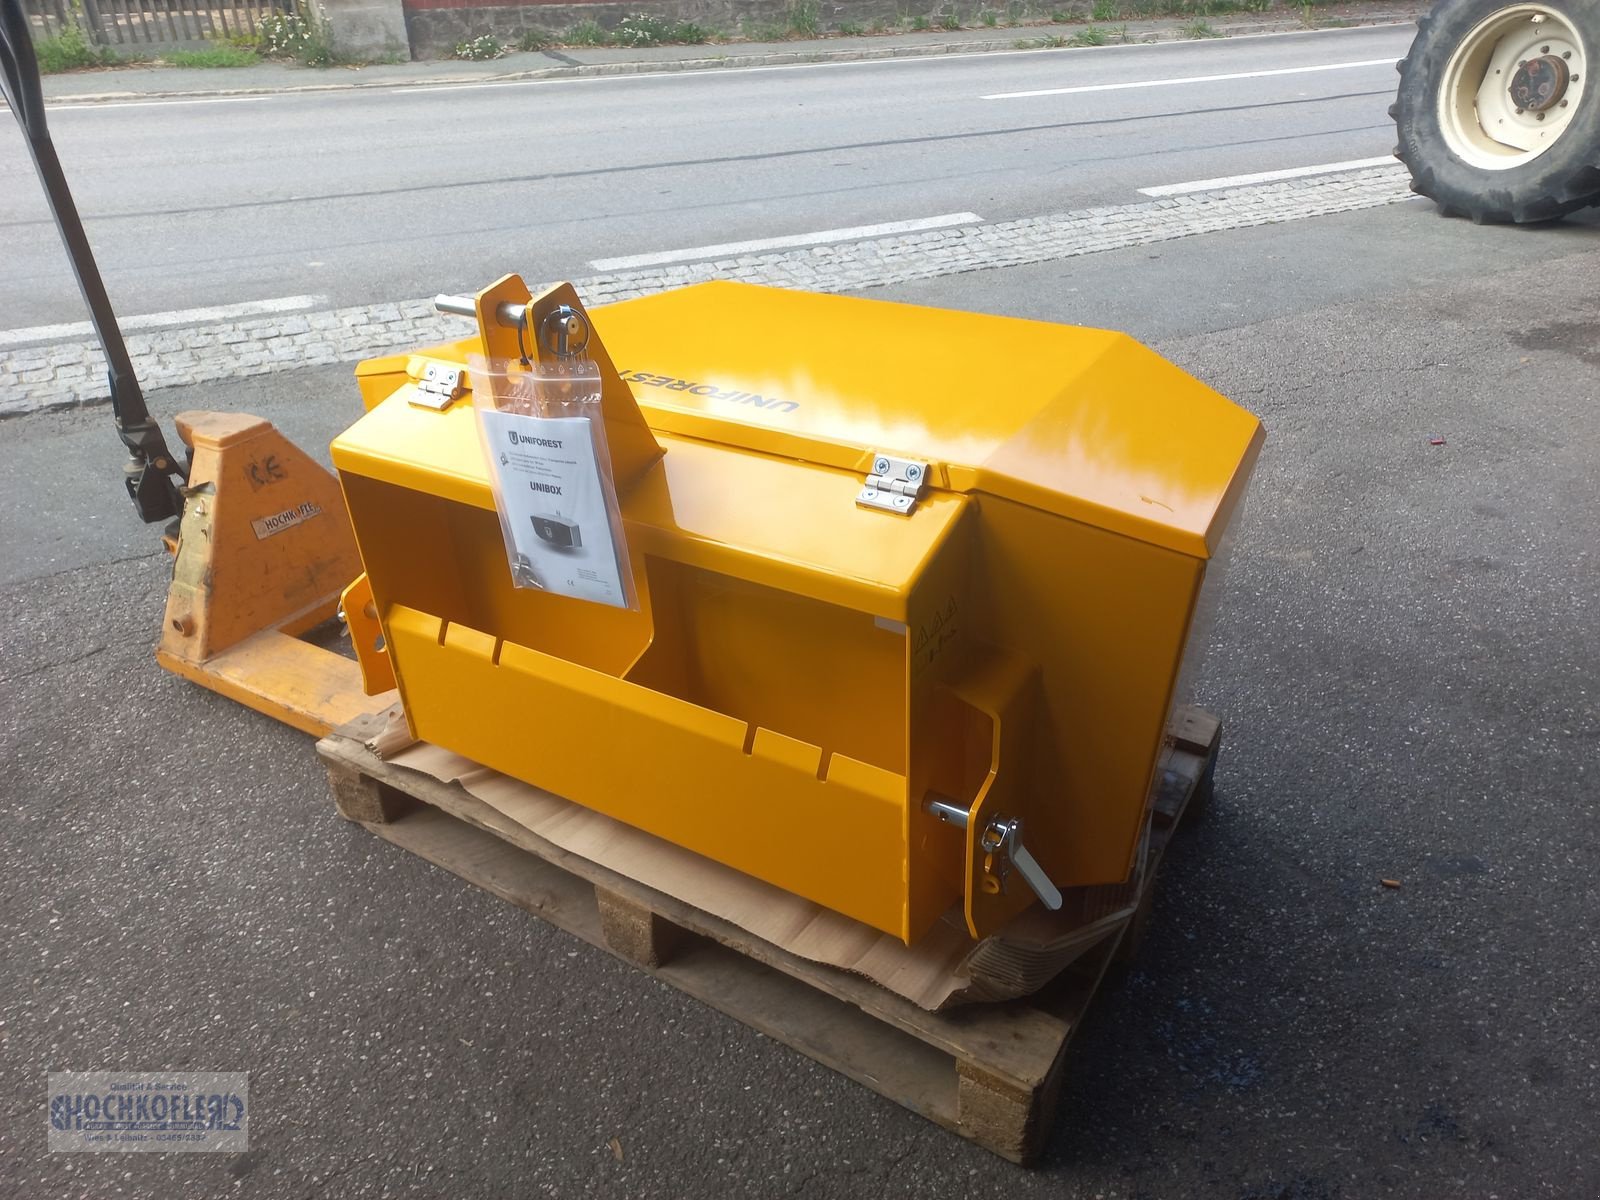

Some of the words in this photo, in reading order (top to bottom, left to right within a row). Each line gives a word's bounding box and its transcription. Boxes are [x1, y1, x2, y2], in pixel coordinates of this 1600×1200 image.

[518, 434, 563, 449] UNIFOREST
[529, 481, 562, 496] UNIBOX
[264, 502, 315, 531] HOCHKFLE
